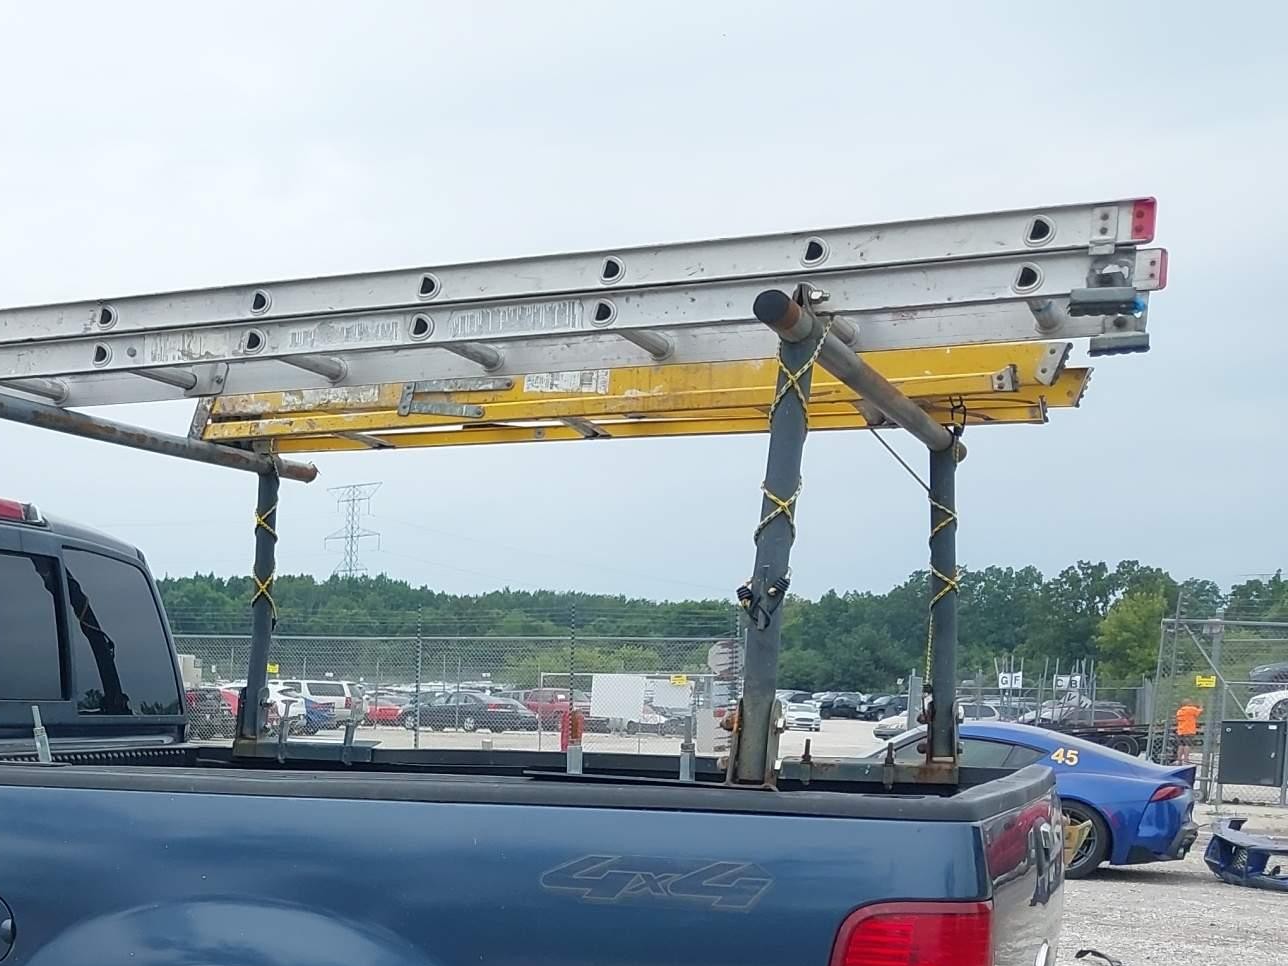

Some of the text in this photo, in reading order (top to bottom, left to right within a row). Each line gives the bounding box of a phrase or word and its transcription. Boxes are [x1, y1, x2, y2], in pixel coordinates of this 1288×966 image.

[1001, 676, 1009, 685] G
[1013, 675, 1021, 685] F
[1050, 747, 1079, 766] 45
